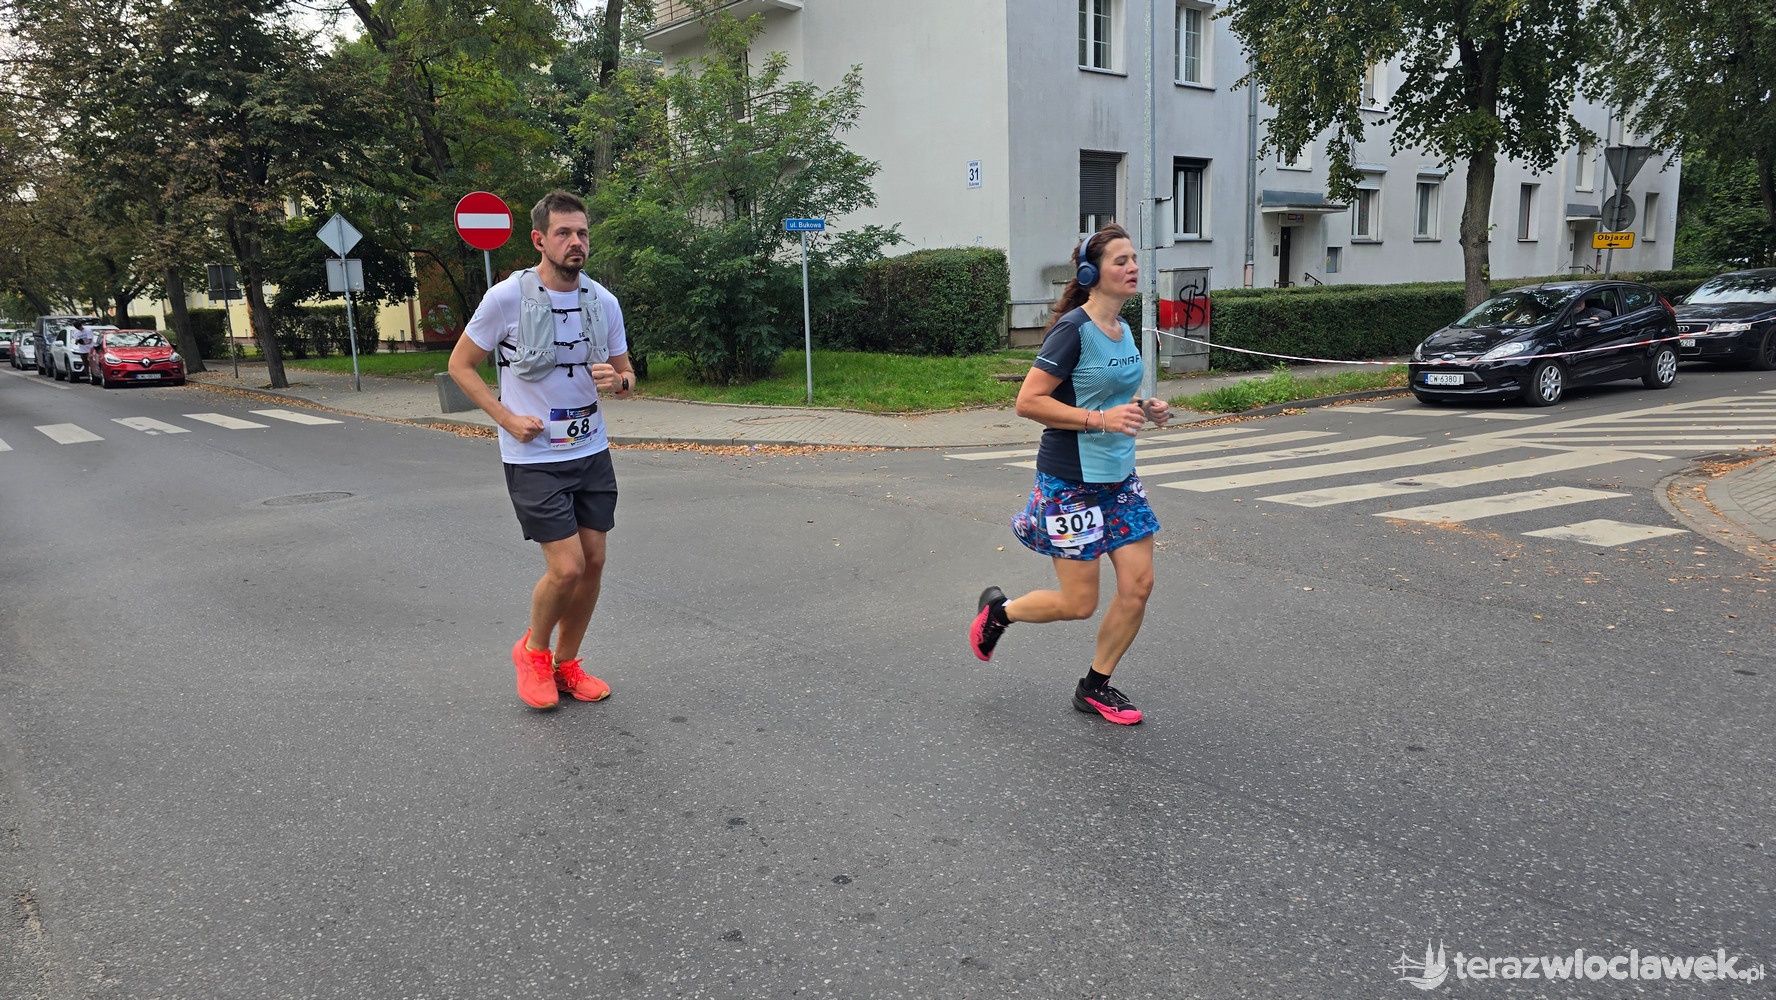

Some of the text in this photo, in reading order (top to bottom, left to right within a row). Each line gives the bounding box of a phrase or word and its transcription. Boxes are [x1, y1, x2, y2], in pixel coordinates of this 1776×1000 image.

[969, 167, 979, 181] 31
[798, 221, 822, 229] Bukowa
[1597, 234, 1631, 242] Objazd
[566, 417, 590, 438] 68
[1055, 510, 1097, 535] 302
